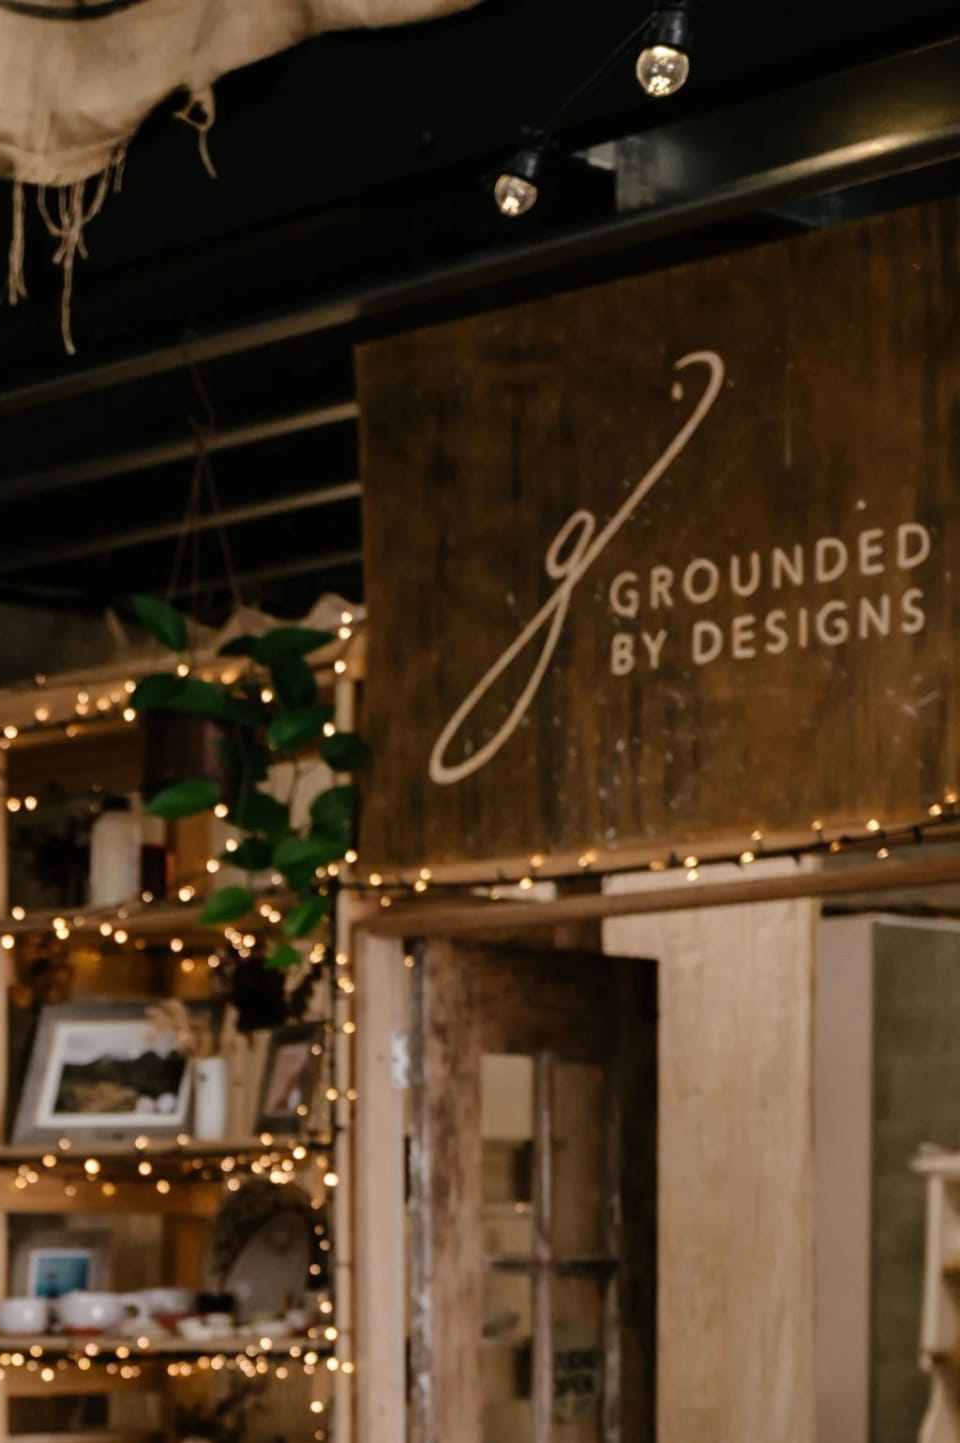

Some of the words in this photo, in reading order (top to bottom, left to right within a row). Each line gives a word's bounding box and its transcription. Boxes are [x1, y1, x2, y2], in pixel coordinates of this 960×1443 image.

[609, 523, 931, 618] GROUNDED
[611, 629, 668, 676] BY
[692, 588, 925, 666] DESIGNS
